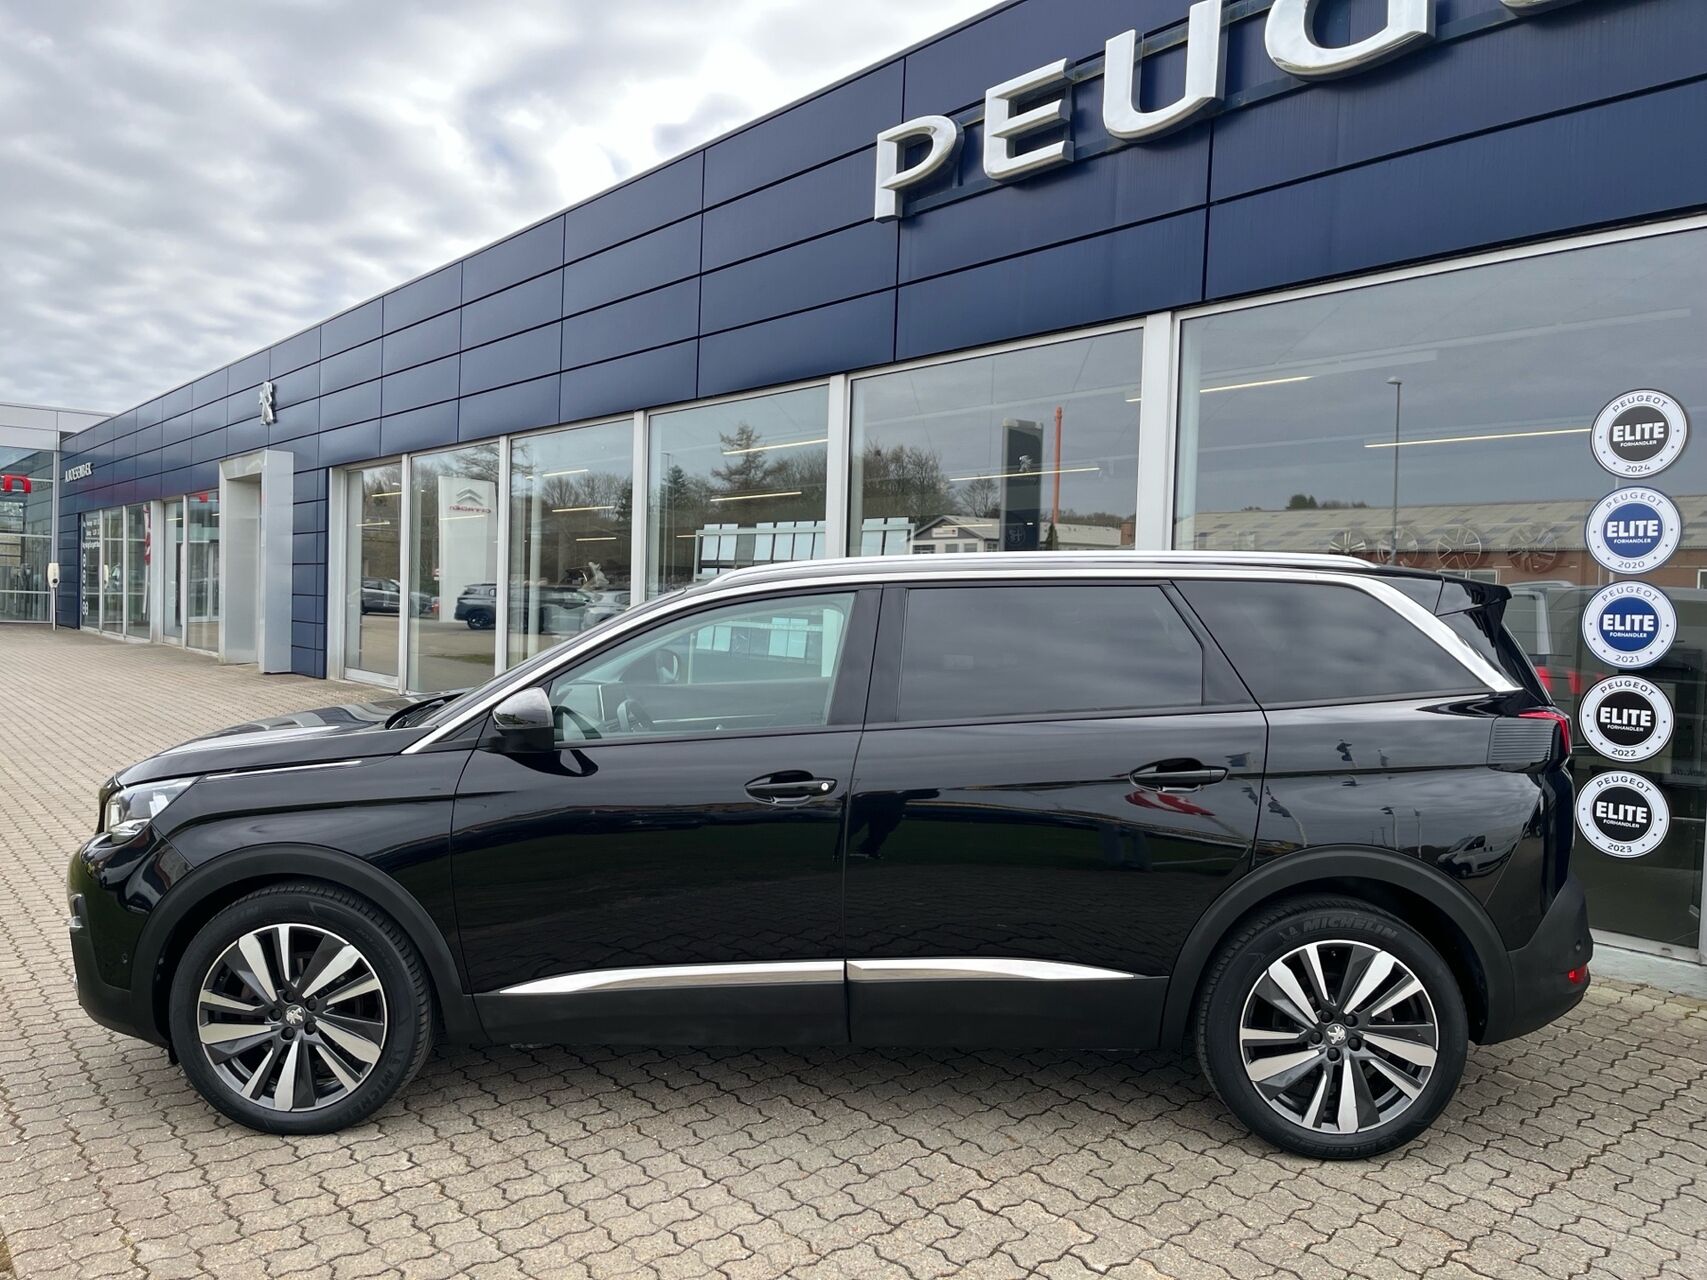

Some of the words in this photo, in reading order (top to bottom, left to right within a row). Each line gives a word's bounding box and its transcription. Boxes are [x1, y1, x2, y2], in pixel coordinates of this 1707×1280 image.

[1612, 394, 1668, 412] PEUGEOT
[1612, 422, 1665, 442] ELITE
[1605, 491, 1663, 509] PEUGEOT
[1606, 519, 1659, 538] ELITE
[1618, 560, 1645, 569] 2020
[1601, 586, 1659, 602] PEUGEOT
[1602, 614, 1655, 632] ELITE
[1614, 654, 1640, 664] 2021
[1599, 680, 1656, 697] PEUGEOT
[1599, 706, 1652, 727] ELITE
[1607, 724, 1644, 732] FORHANDLER
[1611, 747, 1637, 757] 2022
[1596, 775, 1652, 793] PEUGEOT
[1595, 800, 1648, 824] ELITE
[1603, 818, 1640, 828] FORHANDLER
[1607, 843, 1633, 853] 2023
[1303, 917, 1399, 939] MICHELIN
